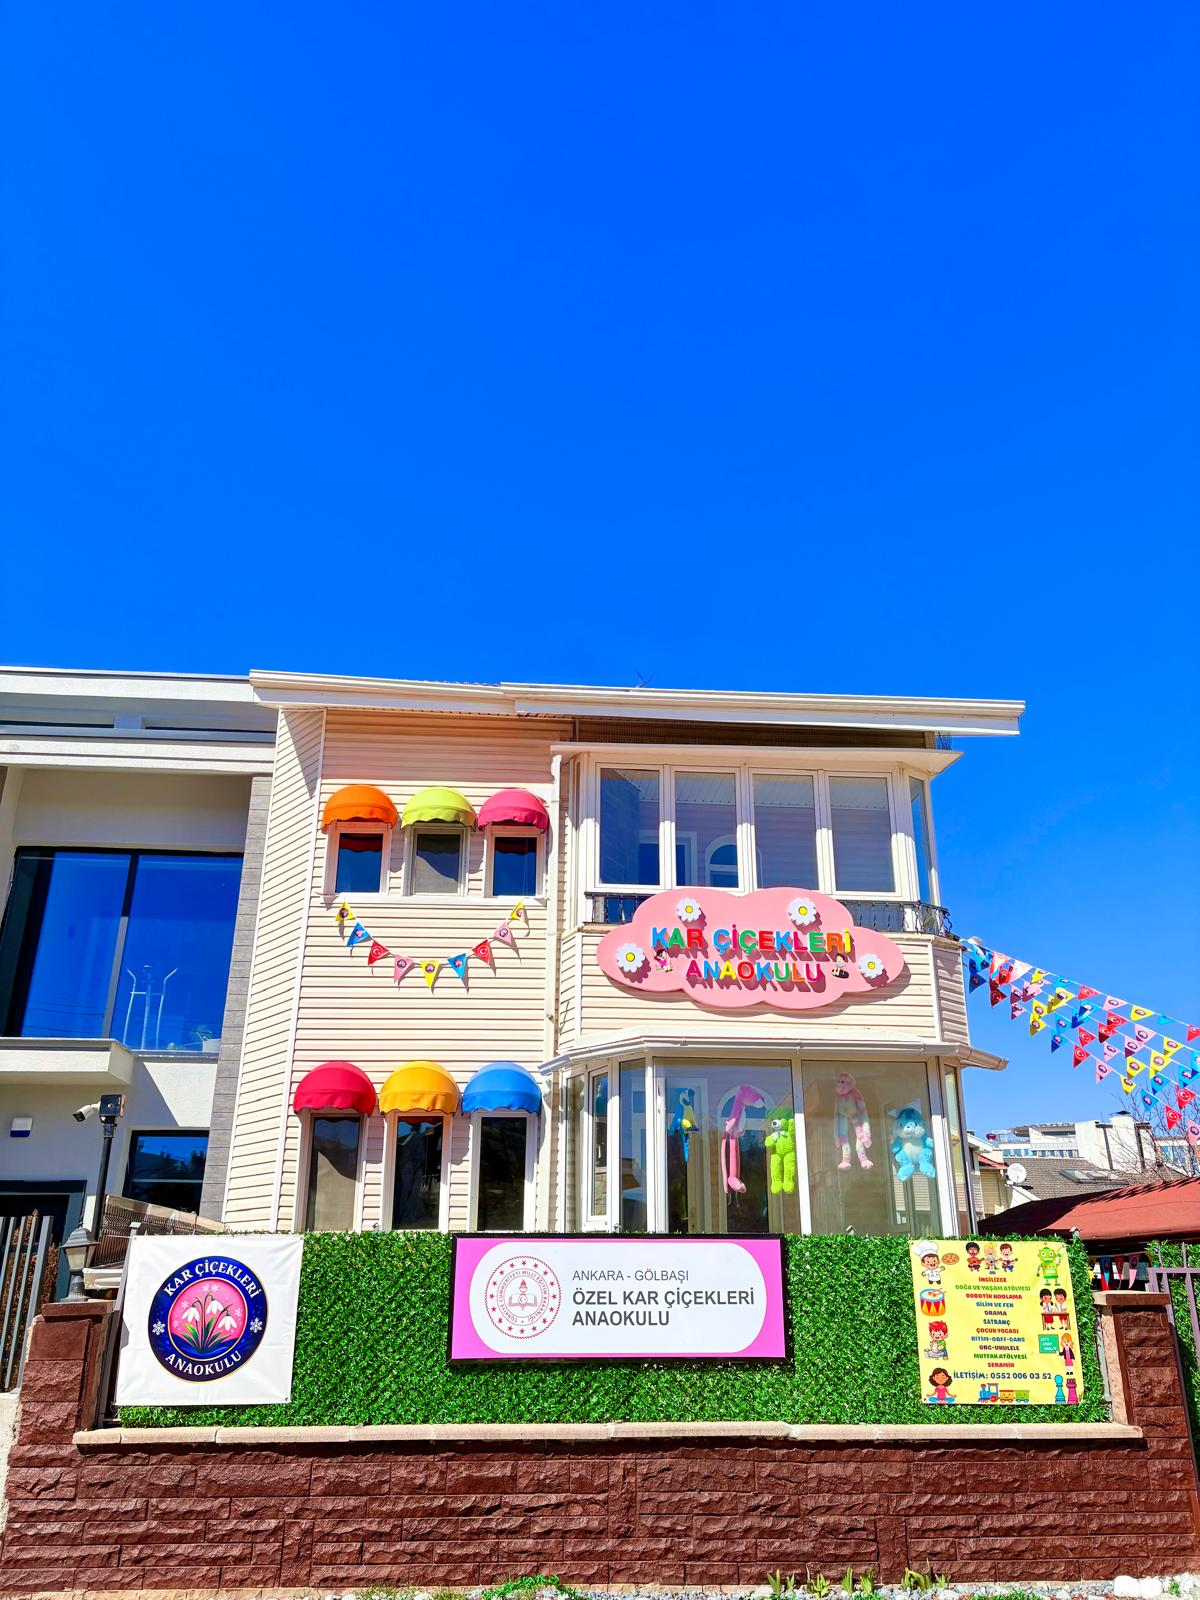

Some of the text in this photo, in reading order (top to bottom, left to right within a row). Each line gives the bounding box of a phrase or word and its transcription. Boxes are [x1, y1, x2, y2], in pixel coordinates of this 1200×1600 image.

[652, 924, 851, 954] KAR ÇİÇEKLERİ
[686, 960, 822, 982] ANAOKULU
[163, 1260, 262, 1298] KAR ÇİÇEKLERİ
[572, 1270, 624, 1281] ANKARA
[635, 1268, 689, 1283] GÖLBAŞI
[572, 1287, 755, 1308] ÖZEL KAR ÇİÇEKLERİ
[572, 1310, 670, 1326] ANAOKULU
[165, 1350, 242, 1375] ANAOKULU
[953, 1370, 988, 1380] İLETİŞİM:
